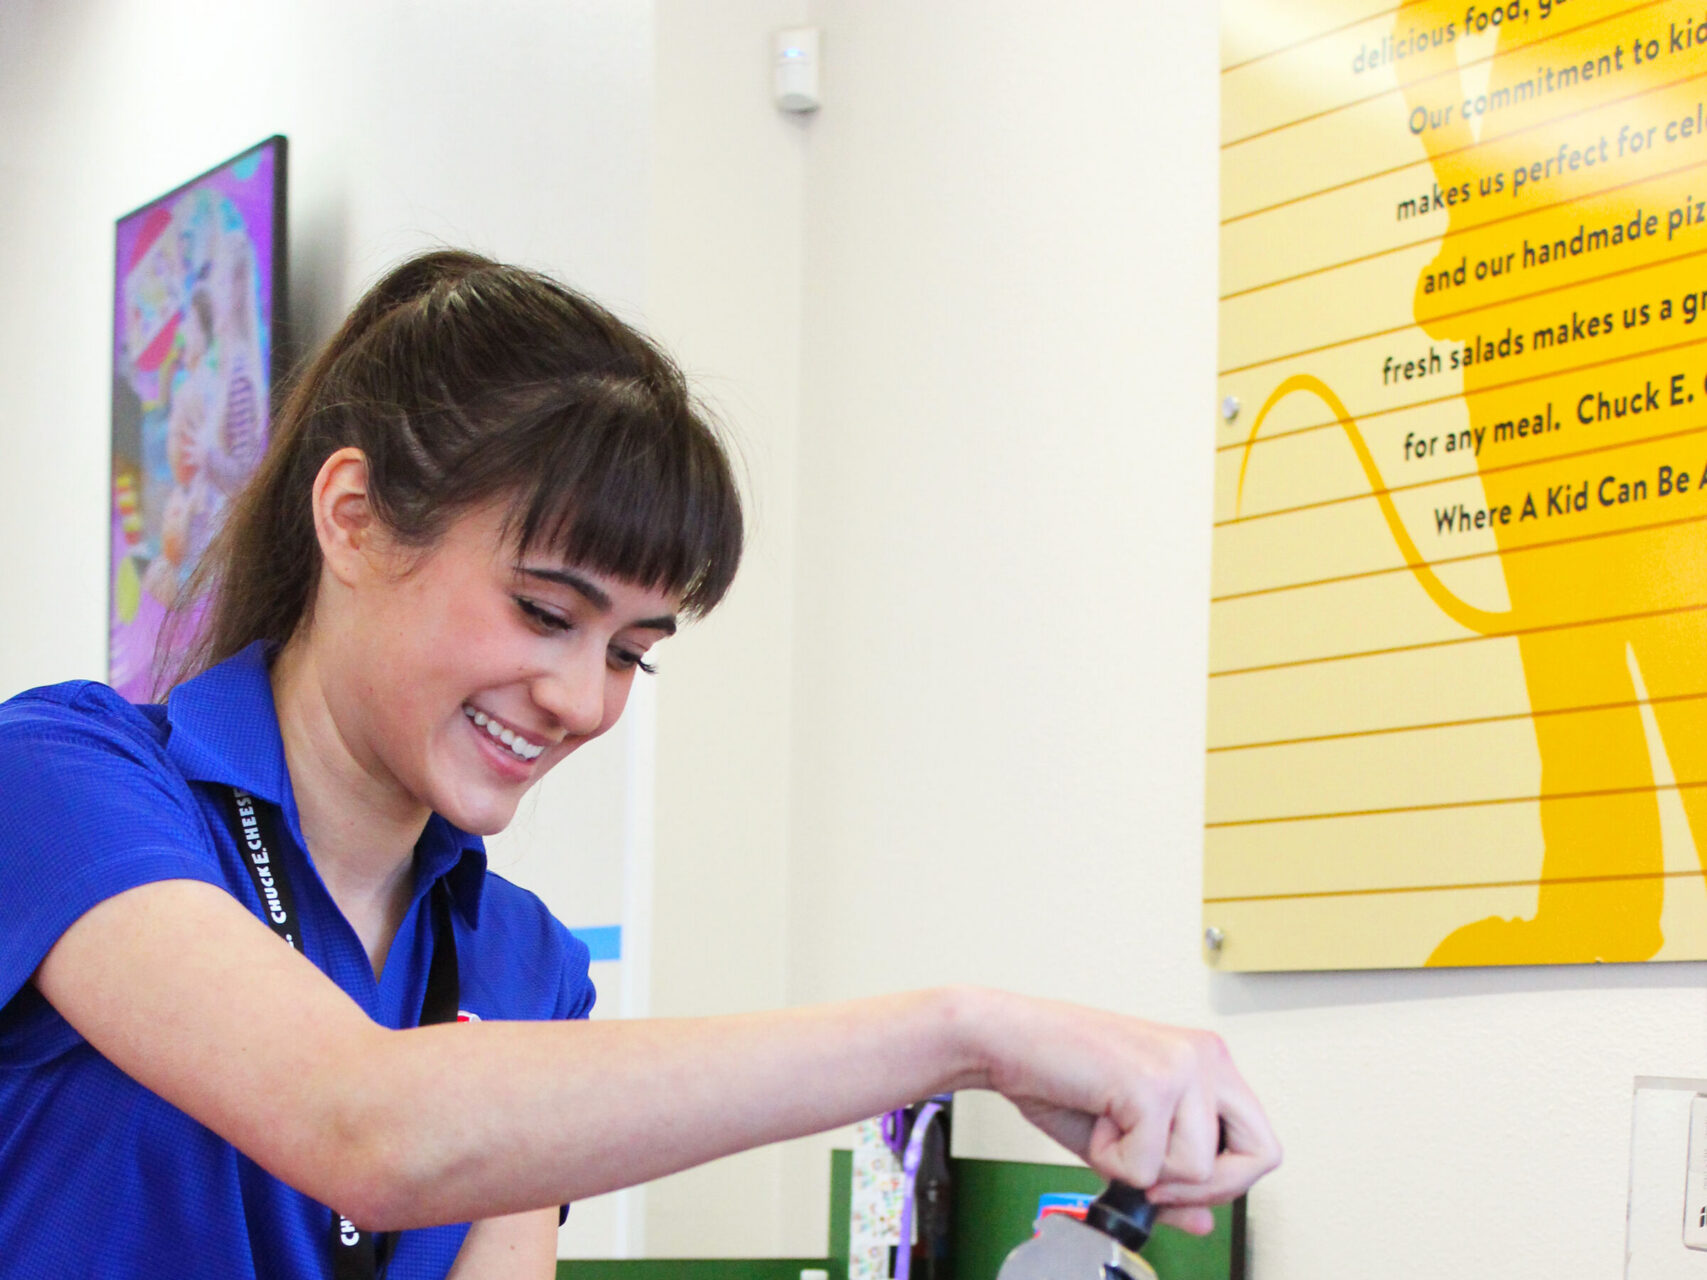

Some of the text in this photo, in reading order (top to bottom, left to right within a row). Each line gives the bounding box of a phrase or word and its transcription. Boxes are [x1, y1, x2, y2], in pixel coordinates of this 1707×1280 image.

[1353, 22, 1456, 74] delicious
[1465, 0, 1530, 35] food,
[1409, 104, 1453, 135] Our
[1461, 45, 1624, 120] commitment
[1633, 38, 1659, 64] to
[1397, 182, 1470, 221] makes
[1479, 172, 1505, 197] us
[1513, 137, 1608, 197] perfect
[1618, 125, 1656, 157] for
[1424, 257, 1467, 295] and
[1475, 251, 1516, 281] our
[1523, 209, 1658, 269] handmade
[1383, 346, 1441, 387] fresh
[1450, 328, 1524, 370] salads
[1533, 311, 1613, 351] makes
[1623, 303, 1650, 329] us
[1660, 299, 1673, 320] a
[1404, 432, 1438, 462] for
[1445, 426, 1486, 457] any
[1493, 402, 1561, 443] meal.
[1577, 380, 1660, 425] Chuck
[1670, 373, 1694, 407] E.
[1434, 503, 1512, 536] Where
[1519, 492, 1538, 522] A
[1546, 480, 1589, 517] Kid
[1598, 475, 1647, 507] Can
[1658, 464, 1690, 497] Be
[256, 865, 287, 925] CHUCK
[339, 1214, 360, 1247] CH
